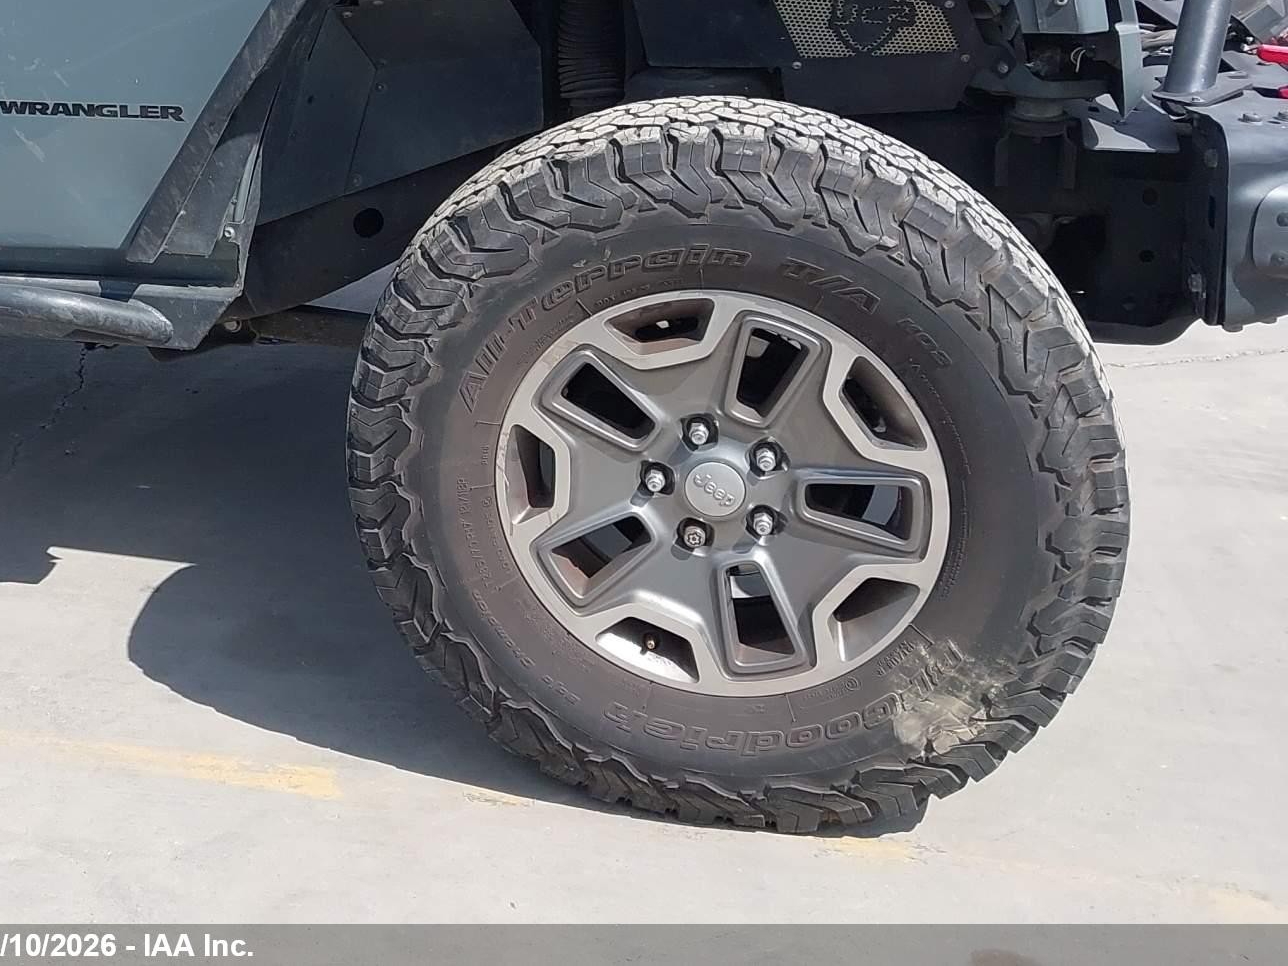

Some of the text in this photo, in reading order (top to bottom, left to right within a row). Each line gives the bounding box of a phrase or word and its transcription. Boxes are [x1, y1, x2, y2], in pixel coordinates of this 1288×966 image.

[0, 100, 185, 122] WRANGLER
[457, 242, 753, 414] All-Terrain
[776, 256, 881, 316] T/A
[693, 474, 736, 507] Jeep
